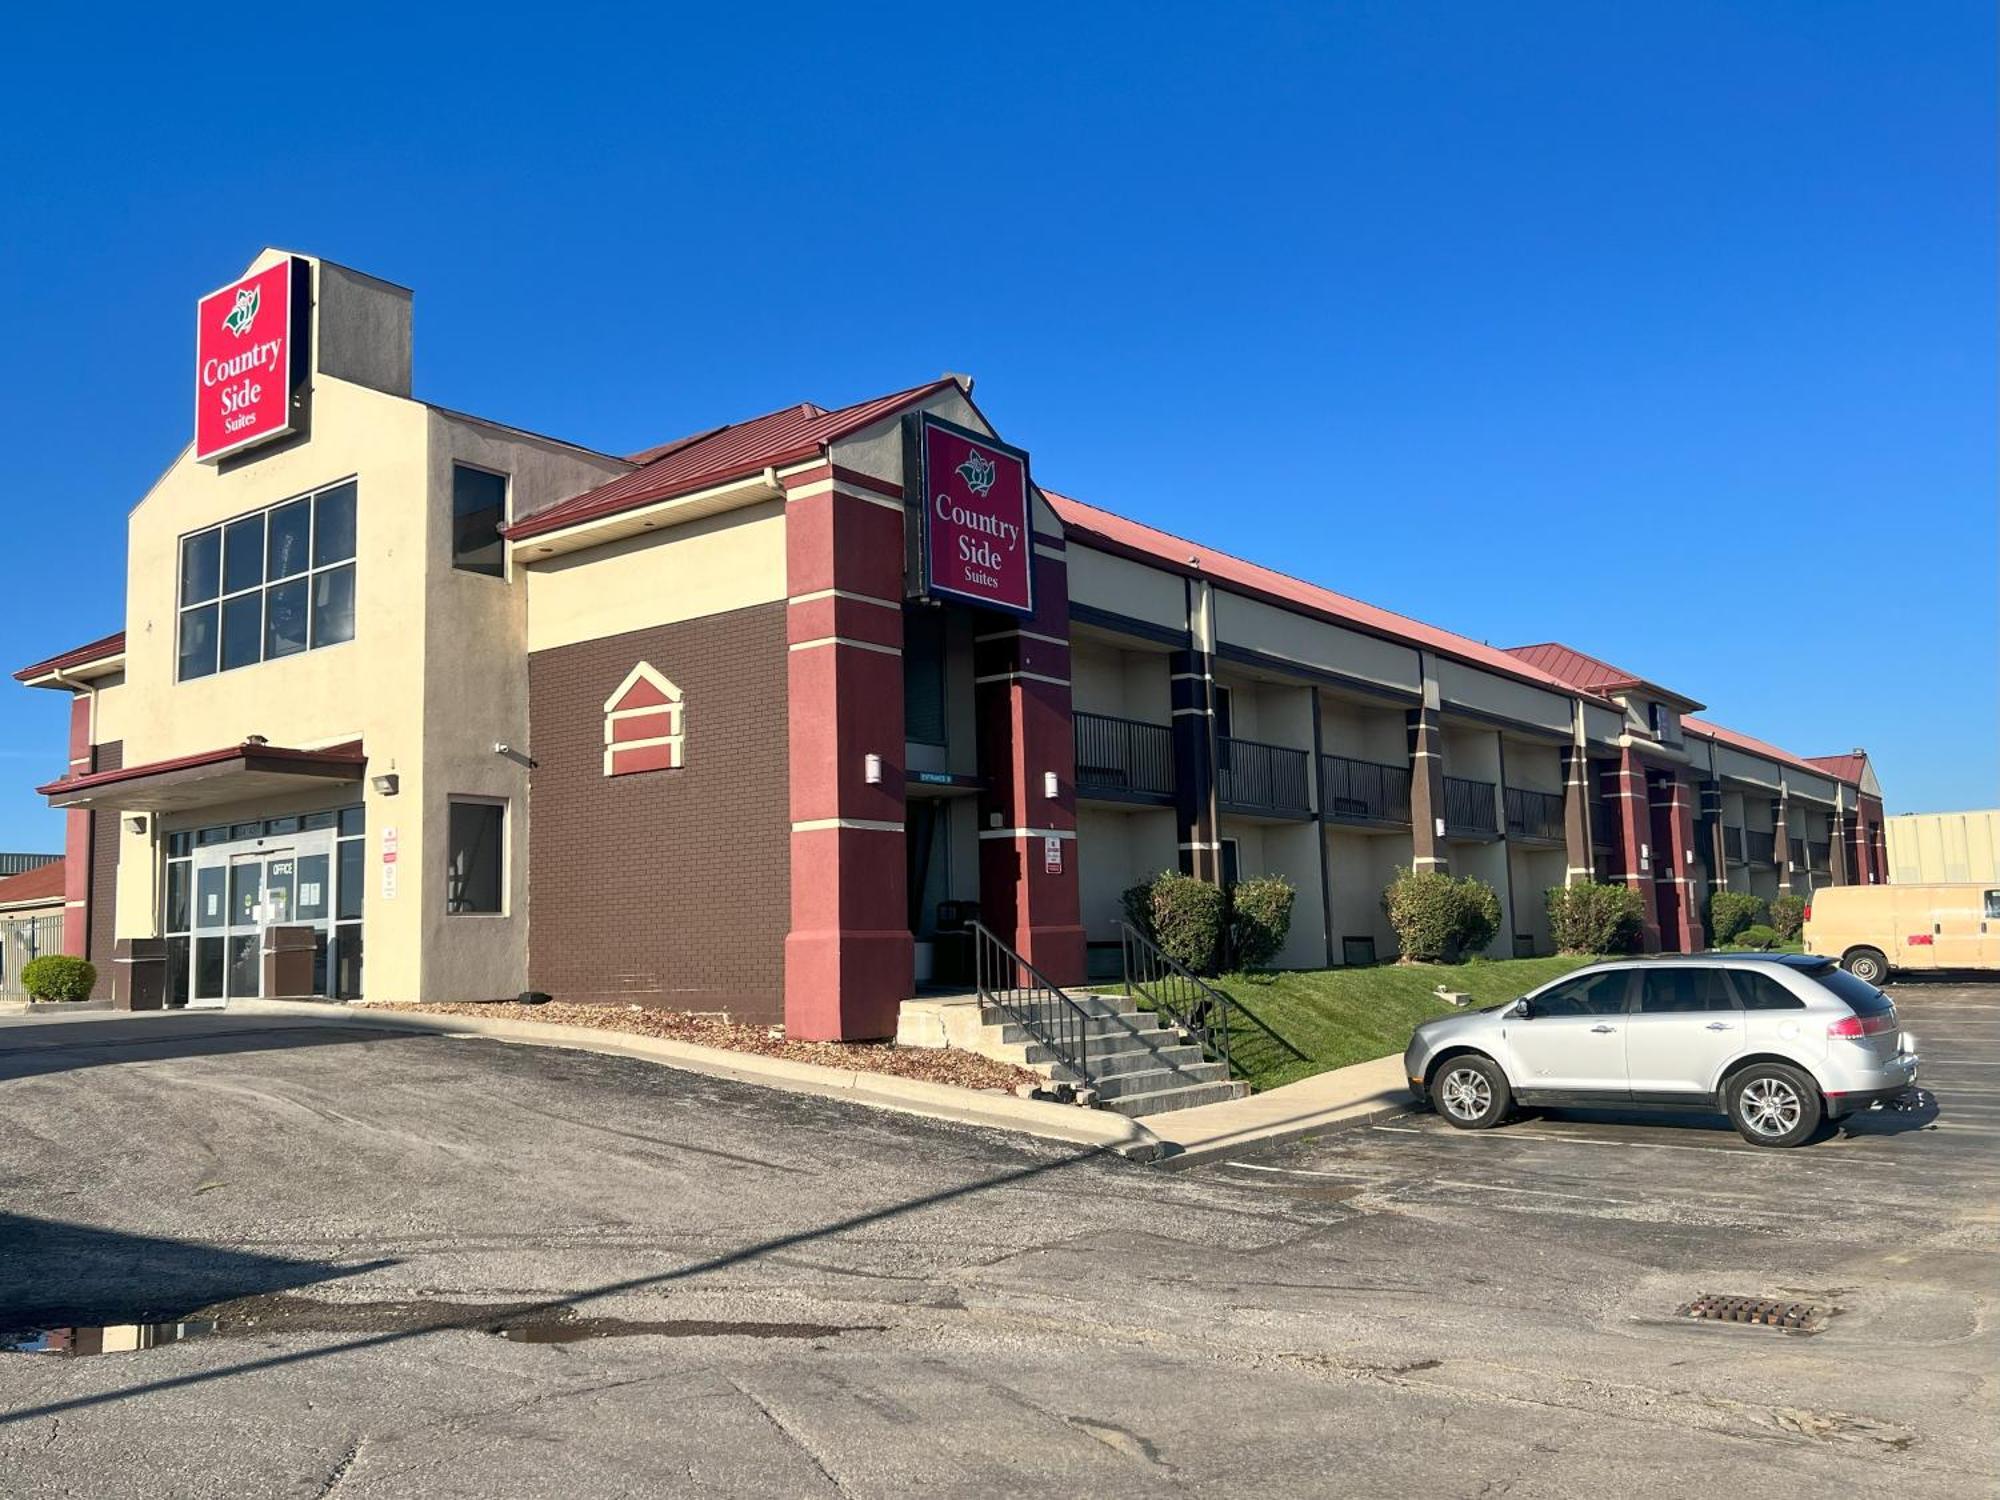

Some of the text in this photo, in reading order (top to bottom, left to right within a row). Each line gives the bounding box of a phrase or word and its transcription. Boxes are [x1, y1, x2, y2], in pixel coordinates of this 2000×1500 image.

[204, 338, 282, 387] Country
[221, 379, 261, 415] Side
[225, 412, 256, 433] Suites
[936, 494, 1019, 550] Country
[959, 535, 1001, 570] Side
[965, 567, 998, 588] Suites
[273, 863, 293, 875] OFFICE
